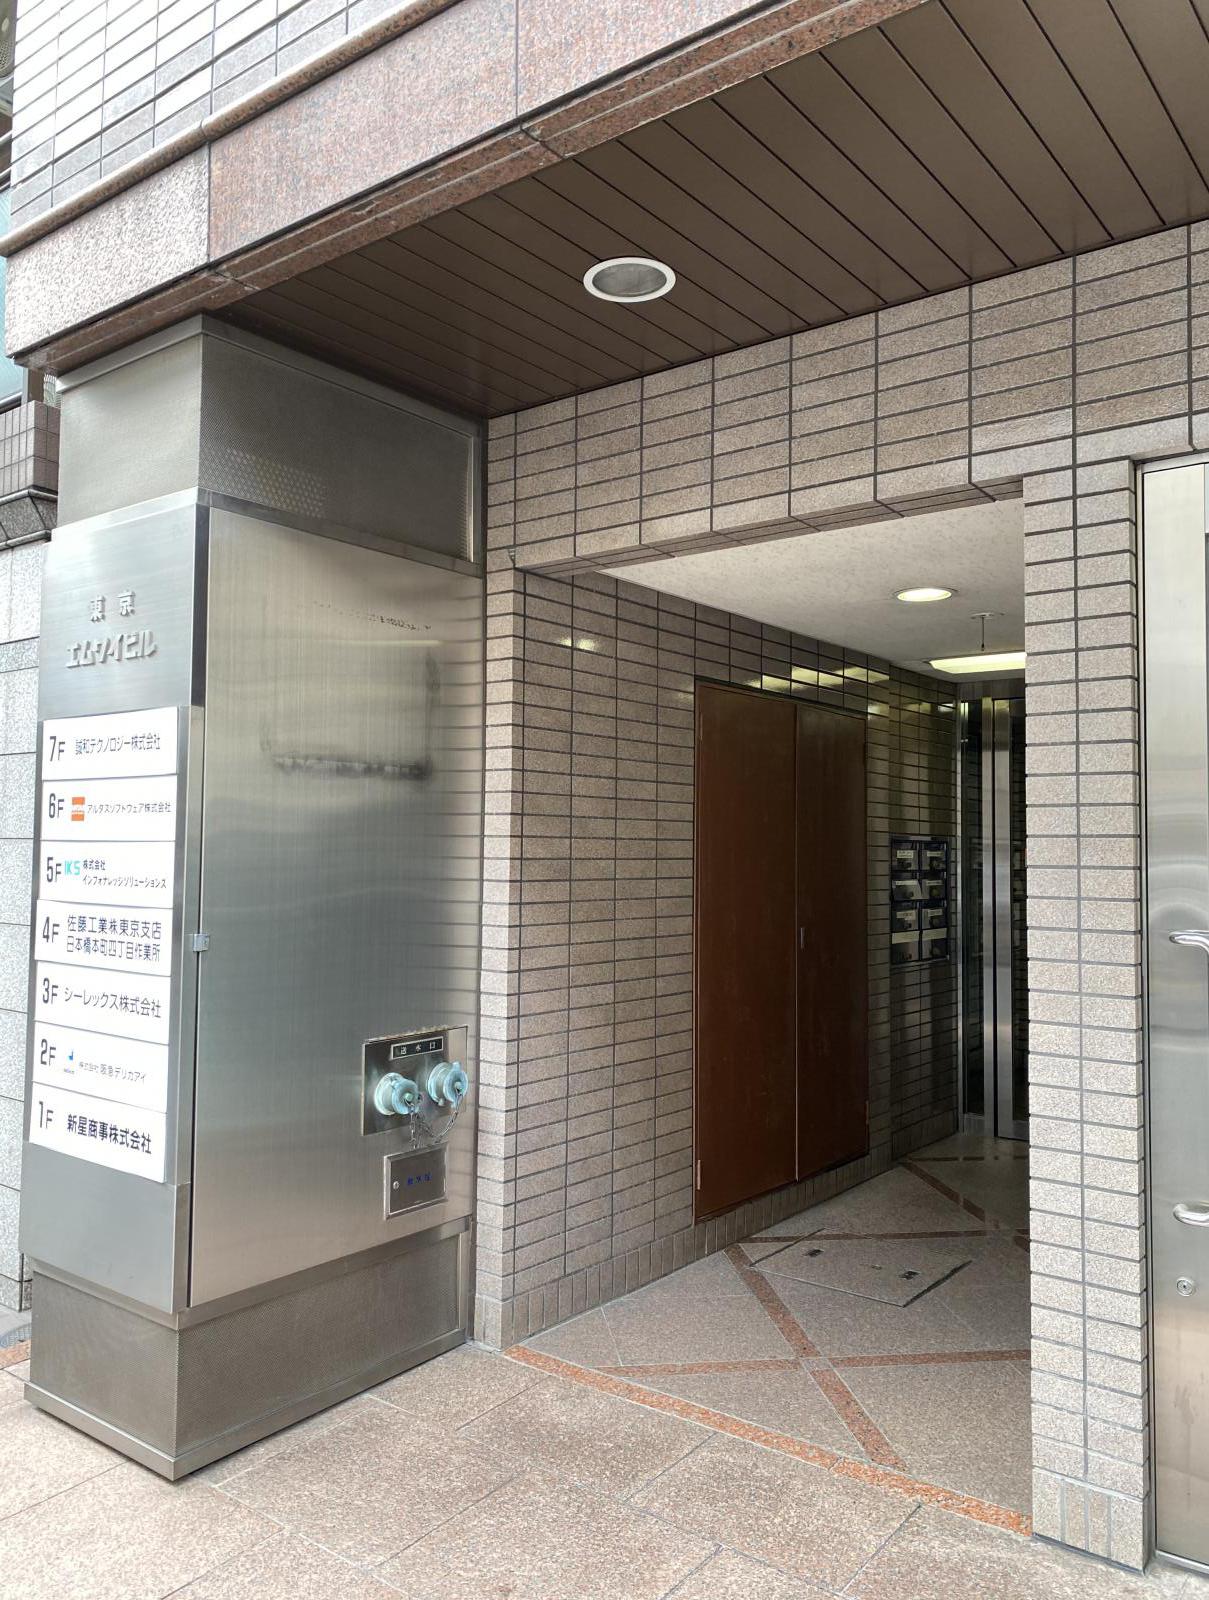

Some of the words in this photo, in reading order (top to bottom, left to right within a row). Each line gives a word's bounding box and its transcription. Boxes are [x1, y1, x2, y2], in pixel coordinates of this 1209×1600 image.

[89, 589, 136, 623] 東京
[49, 736, 66, 762] 7F
[48, 792, 65, 819] 6F
[46, 856, 62, 883] 5F
[64, 860, 81, 876] IKS
[83, 859, 106, 870] 株式会社
[42, 916, 60, 943] 4F
[66, 935, 161, 962] 日本橋本町四丁目作業所
[42, 977, 59, 1005] 3F
[64, 987, 161, 1018] シーレックス株式会社
[40, 1038, 57, 1067] 2F
[38, 1101, 54, 1129] 1F
[66, 1113, 152, 1155] 新星商事株式会社
